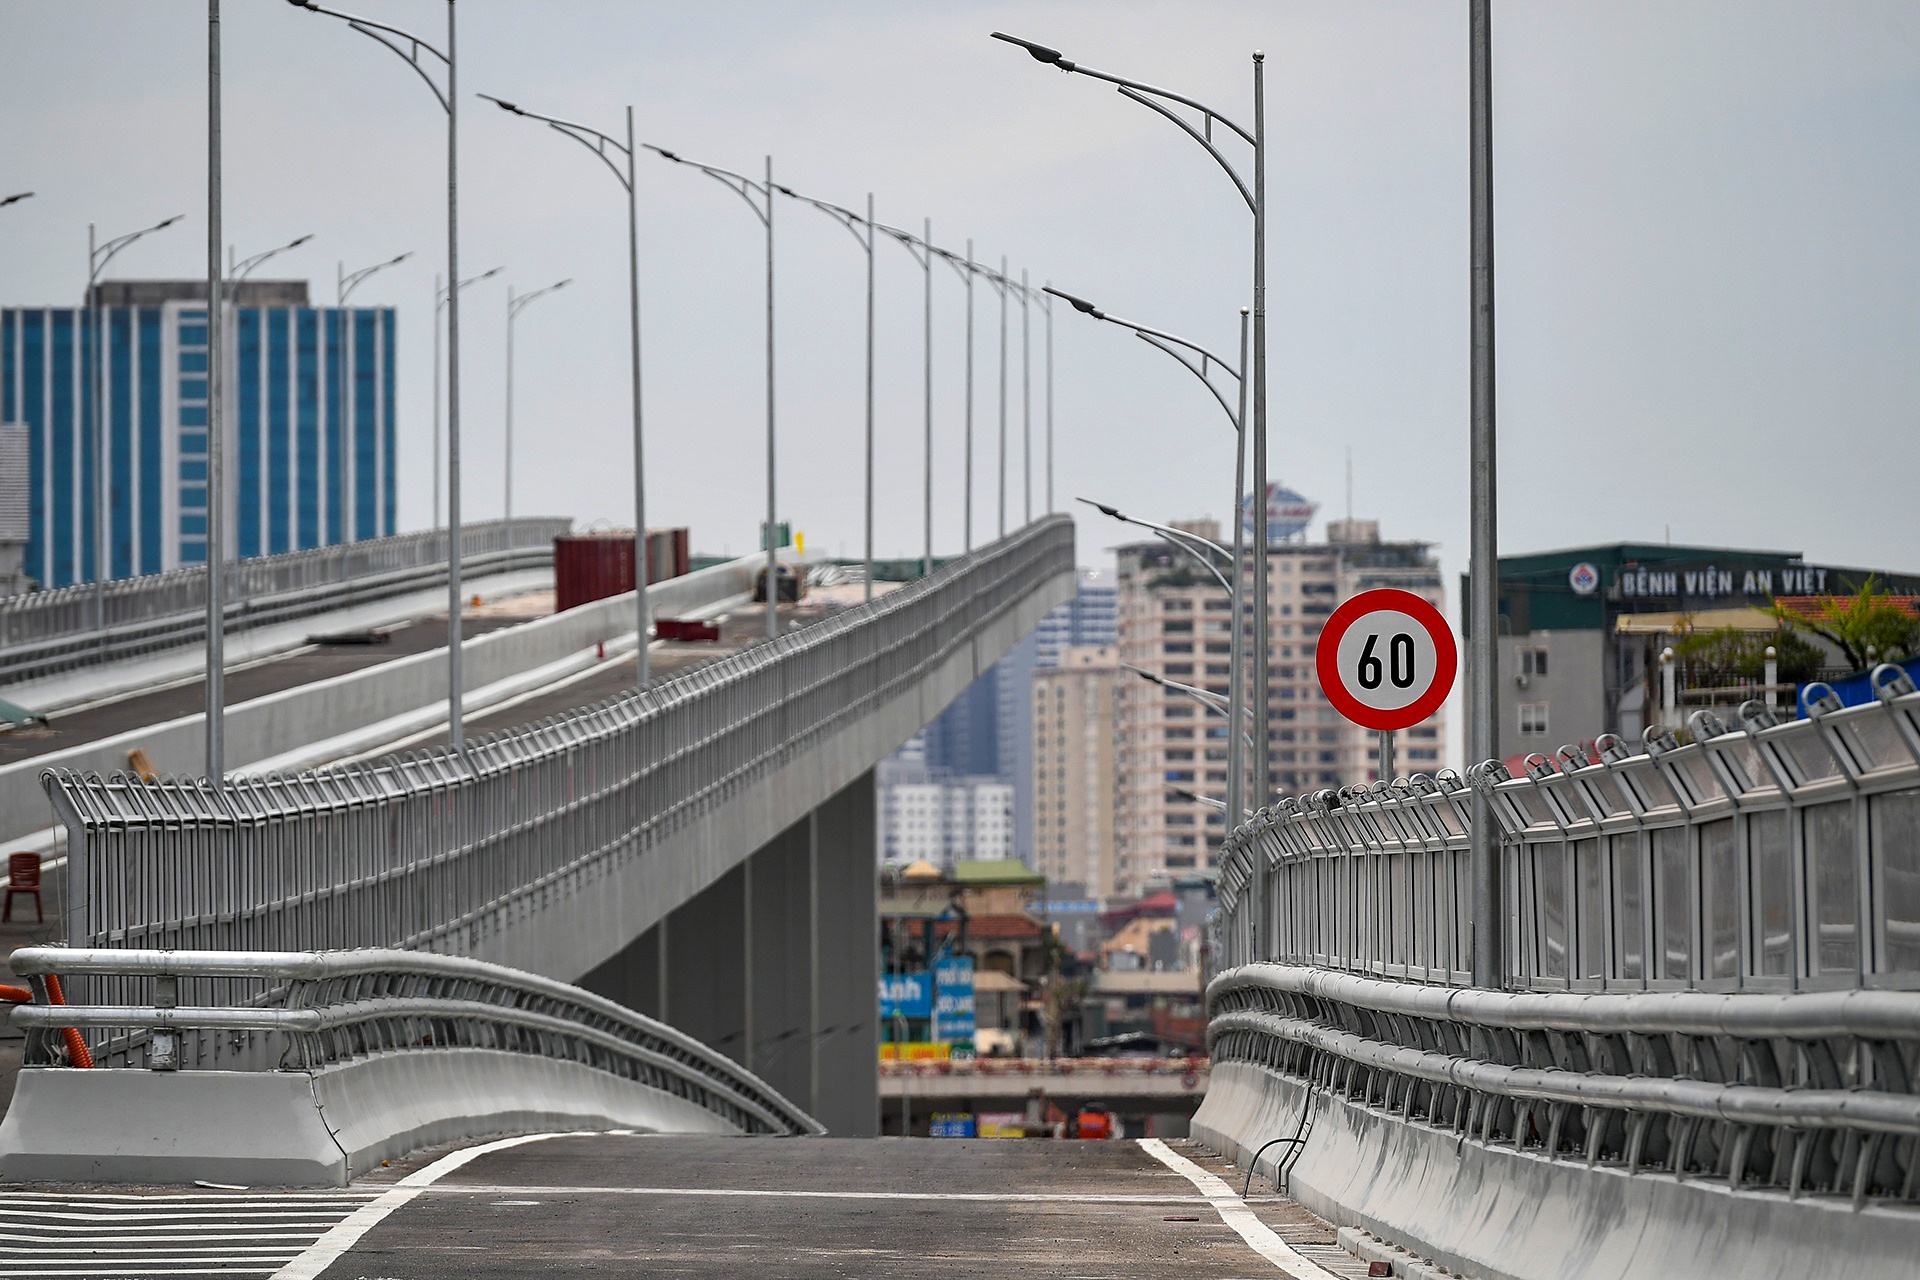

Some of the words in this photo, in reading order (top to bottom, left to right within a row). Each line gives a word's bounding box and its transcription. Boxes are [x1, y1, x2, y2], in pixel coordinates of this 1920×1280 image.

[1684, 565, 1732, 600] VIỆN
[1743, 570, 1772, 594] AN
[1781, 564, 1827, 597] VIỆT
[1357, 632, 1416, 690] 60
